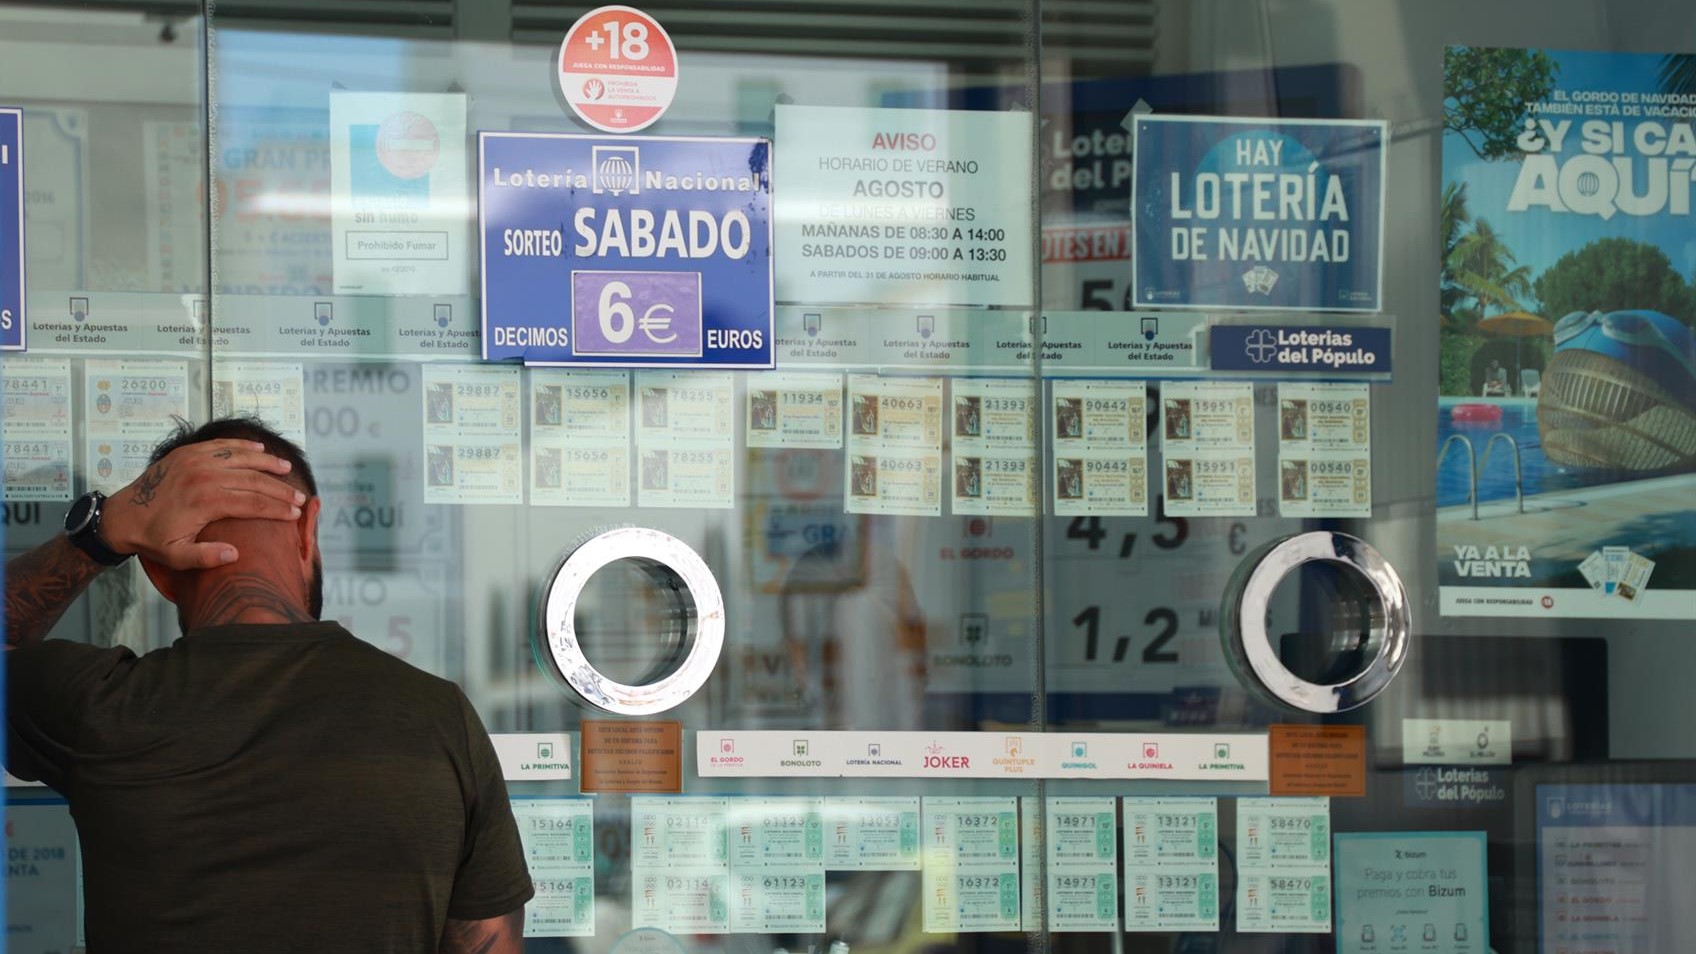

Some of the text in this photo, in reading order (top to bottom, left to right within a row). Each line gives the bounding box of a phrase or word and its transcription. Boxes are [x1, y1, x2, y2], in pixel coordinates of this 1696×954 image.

[585, 21, 650, 61] +18
[572, 62, 666, 74] JUEGA CON RESPONSABILIDAD
[1554, 91, 1570, 102] EL
[1572, 91, 1619, 104] GORDO
[1621, 93, 1638, 104] DE
[1525, 101, 1642, 117] TAMBIÉN ESTÁ DE
[872, 132, 936, 152] AVISO
[1516, 117, 1696, 156] ¿Y SI CA
[1236, 139, 1284, 167] HAY
[819, 157, 979, 175] HORARIO DE VERANO
[494, 167, 588, 189] Lotería
[646, 170, 760, 192] Nacional
[1051, 160, 1104, 190] del
[852, 179, 945, 200] AGOSTO
[1171, 161, 1349, 222] LOTERÍA
[355, 210, 375, 224] sin
[912, 206, 976, 221] VIERNES
[504, 206, 752, 260] SORTEO SABADO
[801, 221, 1005, 241] MAÑANAS DE 08:30 A 14:00
[358, 240, 437, 251] Prohibido Fumar
[1171, 227, 1350, 263] DE NAVIDAD
[802, 244, 1007, 262] SABADOS DE 09:00 A 13:30
[923, 273, 960, 281] HORARIO
[962, 274, 1000, 282] HABITUAL
[75, 323, 81, 334] y
[83, 322, 128, 335] Apuestas
[318, 328, 326, 338] y
[328, 327, 371, 339] Apuestas
[56, 333, 106, 344] del Estado
[300, 337, 350, 348] del Estado
[494, 326, 569, 348] DECIMOS
[707, 329, 764, 350] EUROS
[921, 341, 928, 350] y
[929, 340, 970, 351] Apuestas
[1146, 343, 1153, 353] y
[1153, 342, 1194, 354] Apuestas
[903, 350, 951, 360] del Estado
[1127, 352, 1175, 362] del Estado
[1278, 349, 1376, 369] del Pópulo
[3, 379, 48, 390] 78441
[121, 379, 167, 390] 26200
[456, 384, 500, 397] 29887
[566, 387, 608, 399] 15656
[672, 389, 713, 402] 78255
[782, 392, 823, 404] 11934
[880, 398, 922, 410] 40663
[984, 400, 1026, 412] 21393
[1085, 400, 1127, 412] 90442
[1310, 402, 1351, 414] 00540
[5, 444, 50, 455] 78441
[456, 447, 501, 459] 29887
[566, 450, 608, 462] 15656
[671, 451, 714, 463] 78255
[880, 459, 922, 472] 40663
[985, 460, 1027, 473] 21393
[1086, 461, 1128, 473] 90442
[1310, 462, 1352, 474] 00540
[961, 546, 1014, 560] GORDO
[1454, 545, 1531, 561] YA A LA
[1454, 561, 1532, 578] VENTA
[1073, 605, 1180, 664] 1,2
[718, 756, 744, 764] GORDO
[780, 759, 822, 768] BONOLOTO
[872, 759, 903, 767] NACIONAL
[923, 755, 971, 770] JOKER
[521, 763, 569, 771] LA PRIMITIVA
[1003, 765, 1024, 773] PLUS
[1127, 762, 1173, 771] LA QUINIELA
[1199, 763, 1245, 772] LA PRIMITIVA
[1437, 784, 1505, 805] del Pópulo
[531, 819, 573, 830] 15164
[958, 816, 999, 828] 16372
[1056, 816, 1096, 828] 14971
[1157, 815, 1198, 827] 13121
[1270, 819, 1312, 829] 58470
[1364, 868, 1393, 883] Paga
[1396, 870, 1404, 881] y
[763, 878, 806, 889] 61123
[958, 877, 1000, 889] 16372
[1056, 877, 1097, 889] 14971
[1158, 876, 1199, 888] 13121
[1270, 879, 1312, 890] 58470
[1428, 884, 1467, 897] Bizum
